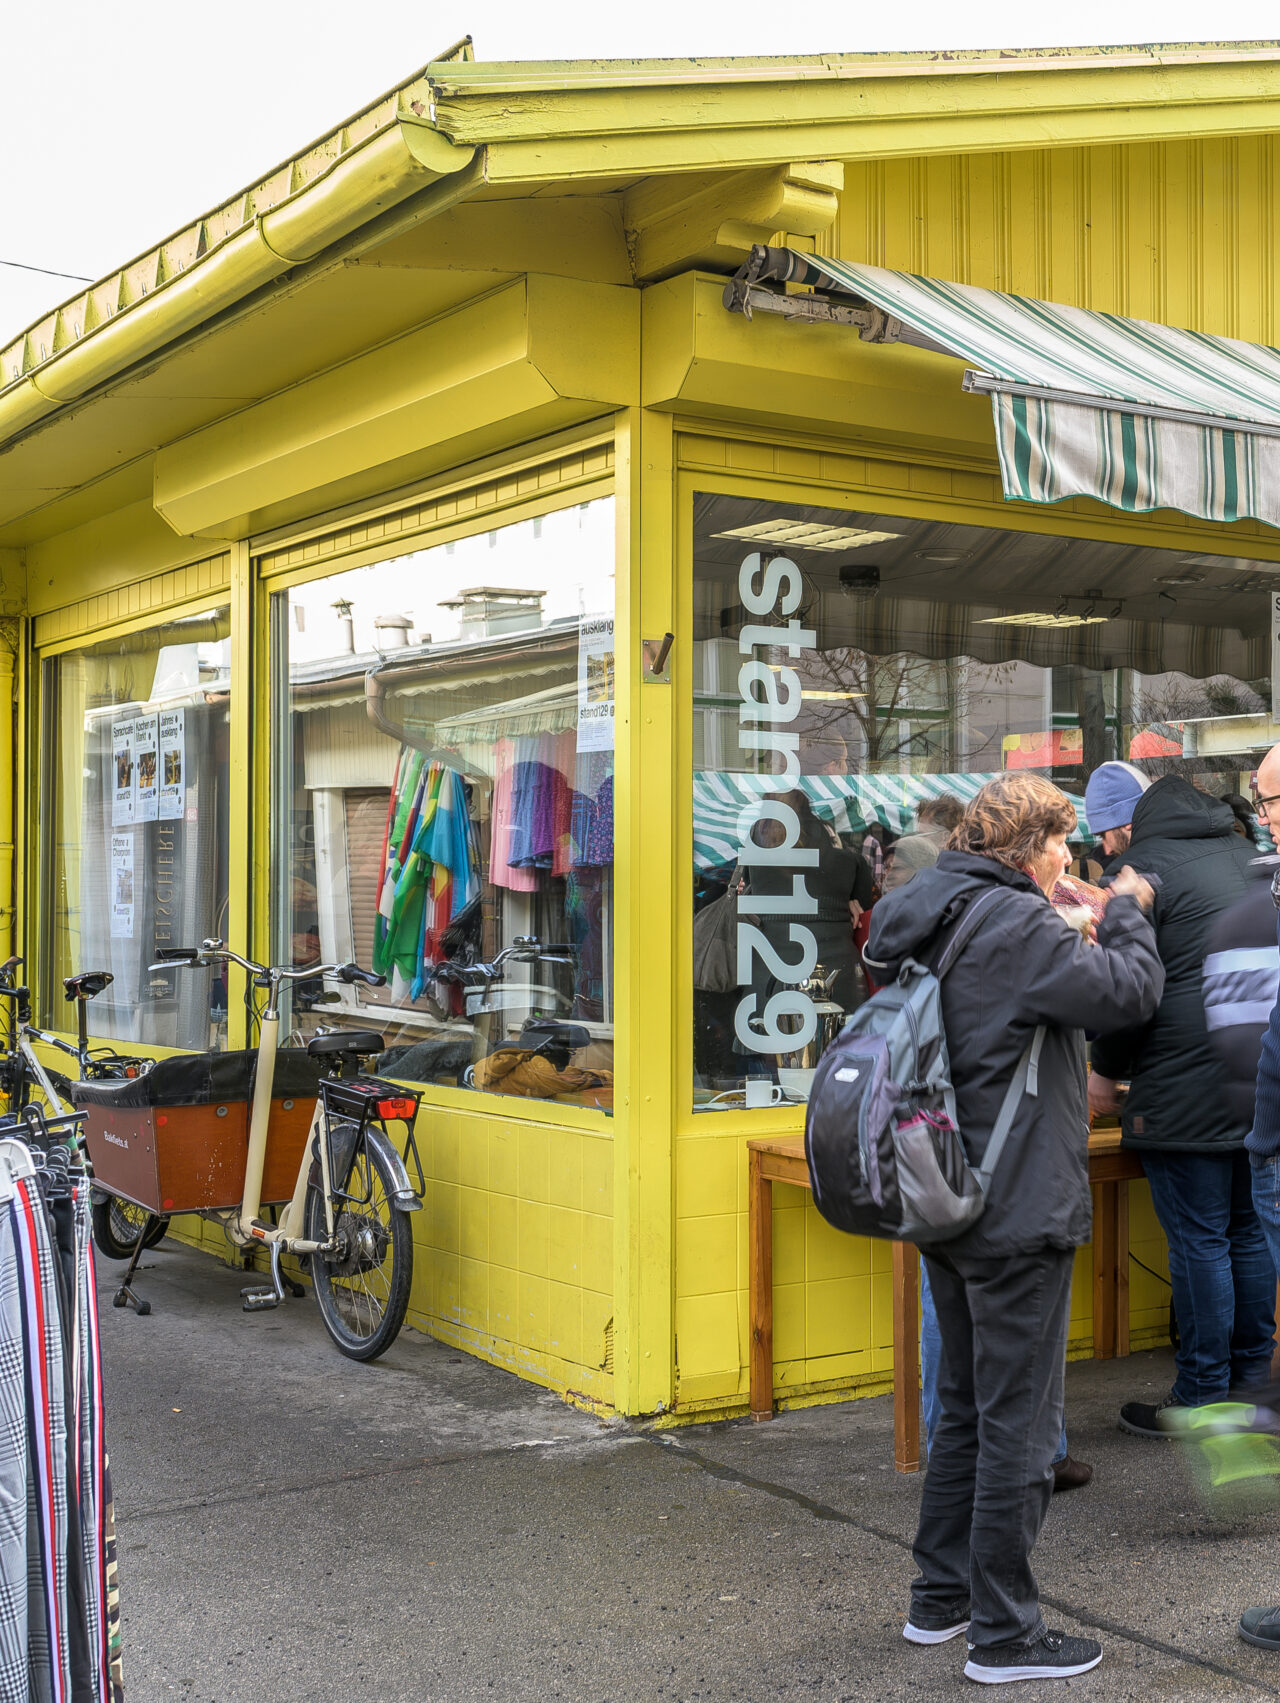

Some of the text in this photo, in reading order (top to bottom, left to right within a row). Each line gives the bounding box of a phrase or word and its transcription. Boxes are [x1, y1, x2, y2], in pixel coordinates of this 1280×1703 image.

[581, 620, 614, 636] ausklang
[580, 704, 609, 719] stand129
[734, 552, 819, 1055] stand129
